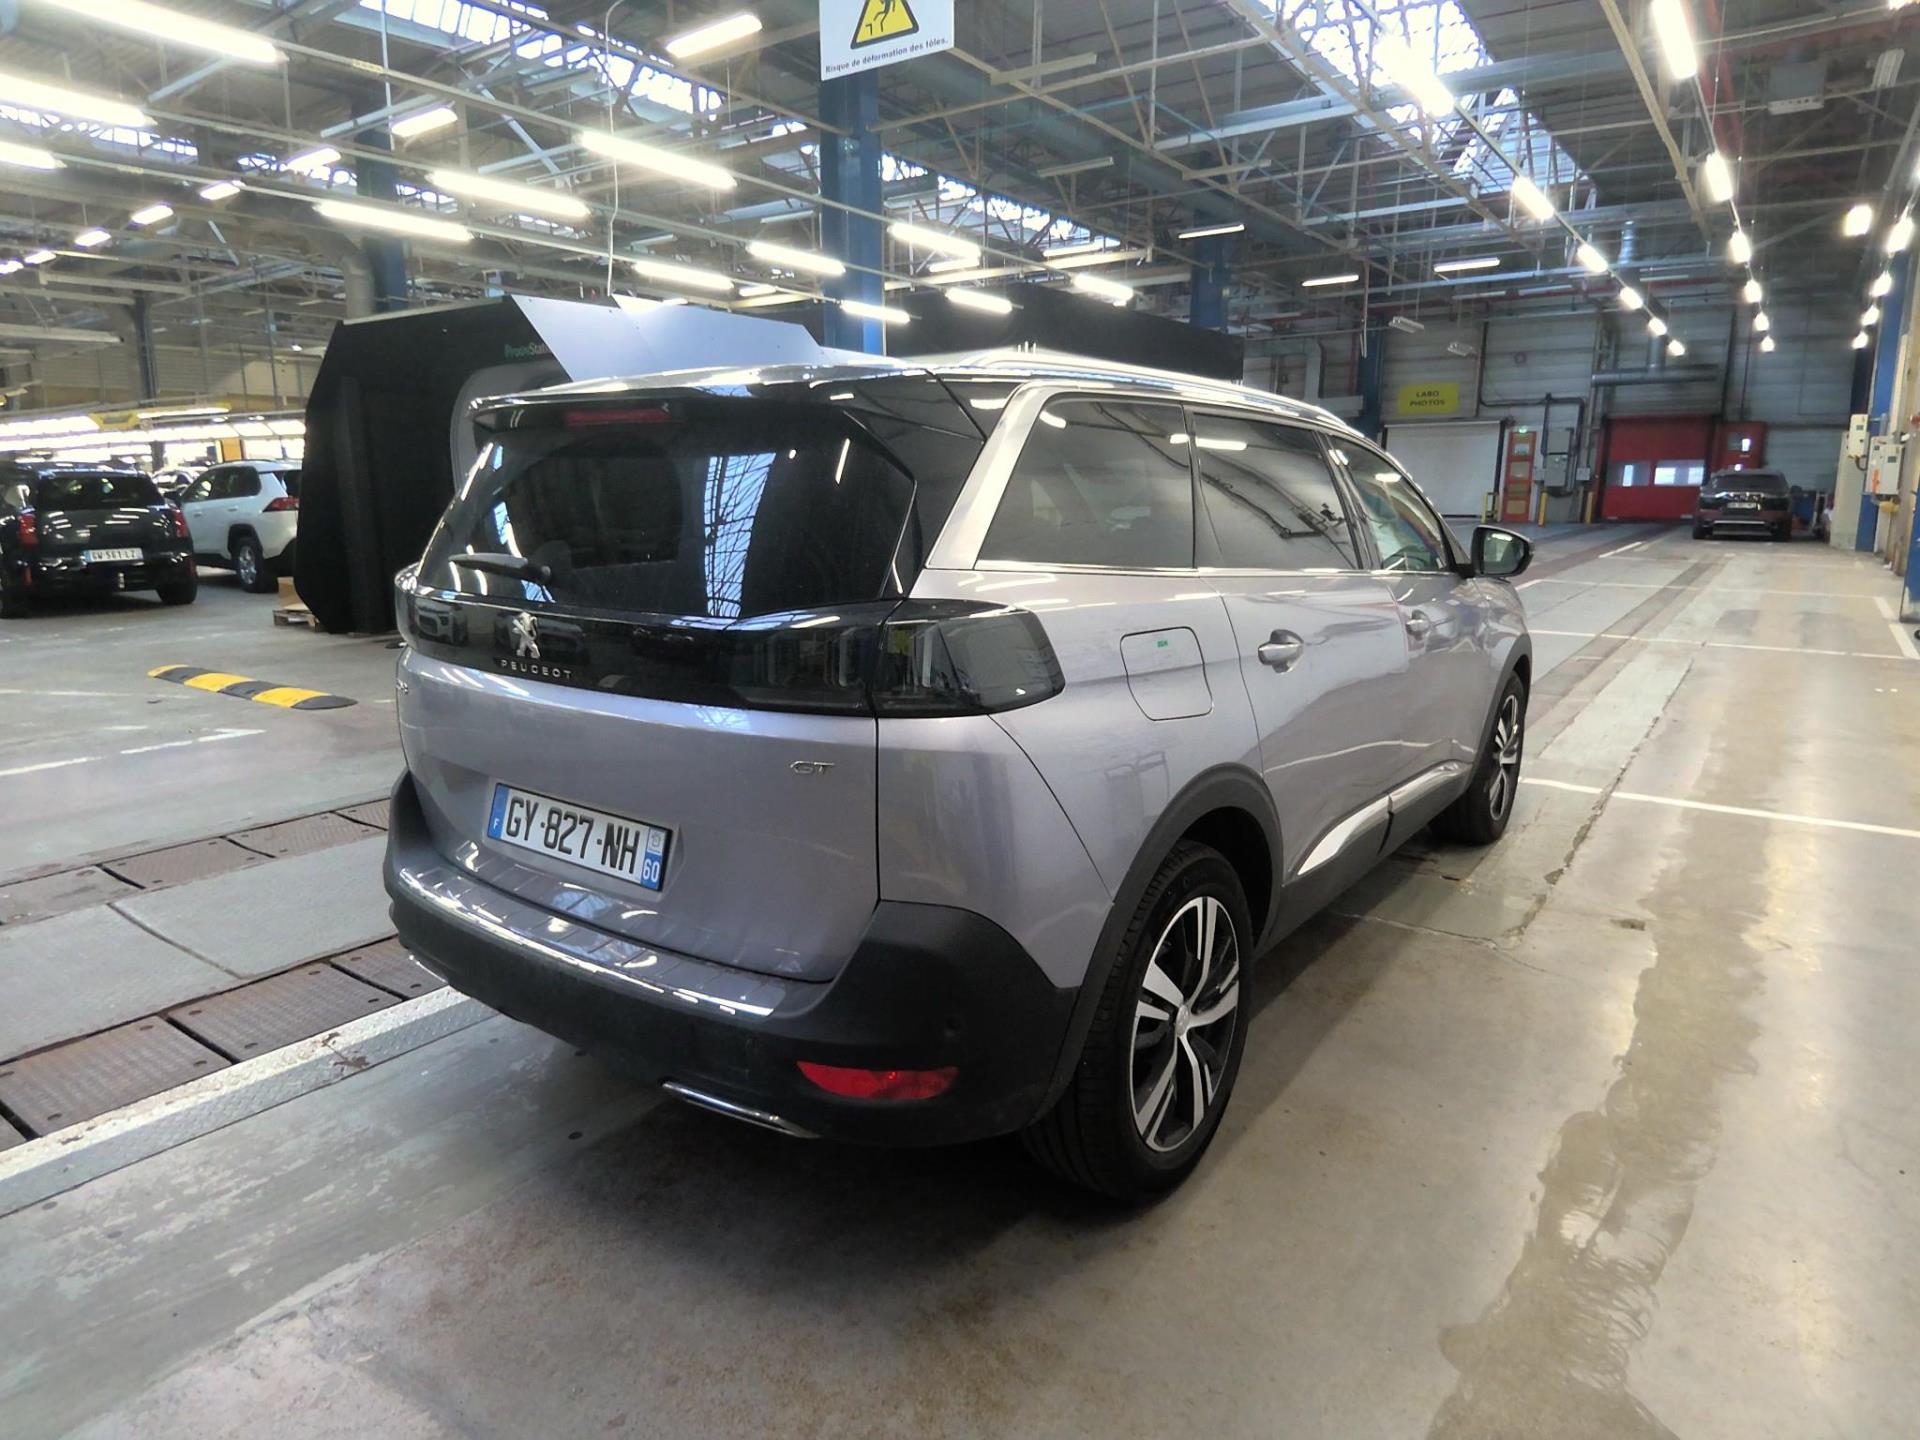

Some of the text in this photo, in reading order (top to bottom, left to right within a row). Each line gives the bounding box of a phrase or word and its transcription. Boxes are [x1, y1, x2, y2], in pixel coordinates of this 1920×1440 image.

[825, 62, 850, 73] Risque
[851, 59, 860, 67] de
[862, 47, 908, 63] déformation
[910, 43, 923, 53] des
[1416, 390, 1440, 398] LABO
[501, 659, 571, 679] PEUGEOT
[790, 760, 835, 774] GT
[493, 796, 660, 883] F GY-827-NH 60
